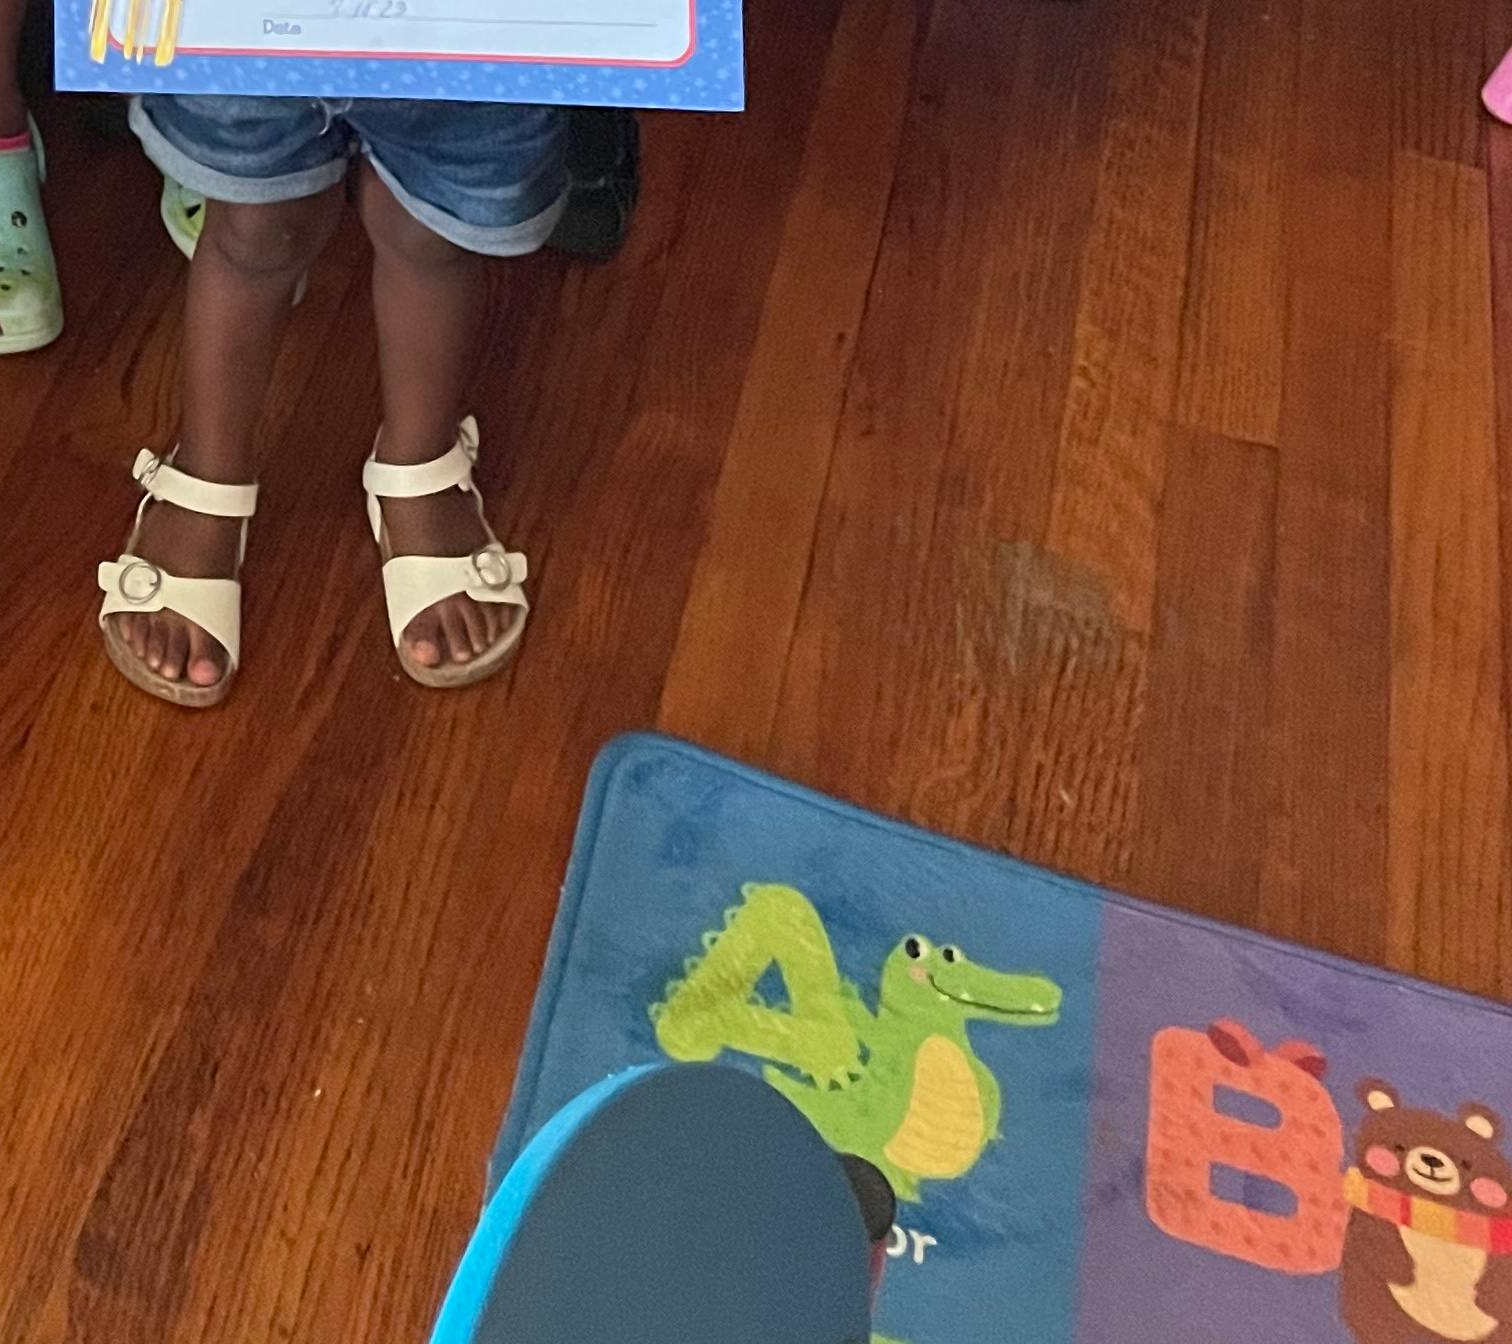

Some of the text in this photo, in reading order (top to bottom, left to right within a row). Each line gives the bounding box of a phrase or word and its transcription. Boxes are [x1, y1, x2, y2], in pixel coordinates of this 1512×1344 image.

[262, 18, 303, 36] Date
[649, 882, 869, 1092] A
[1147, 1020, 1348, 1276] B
